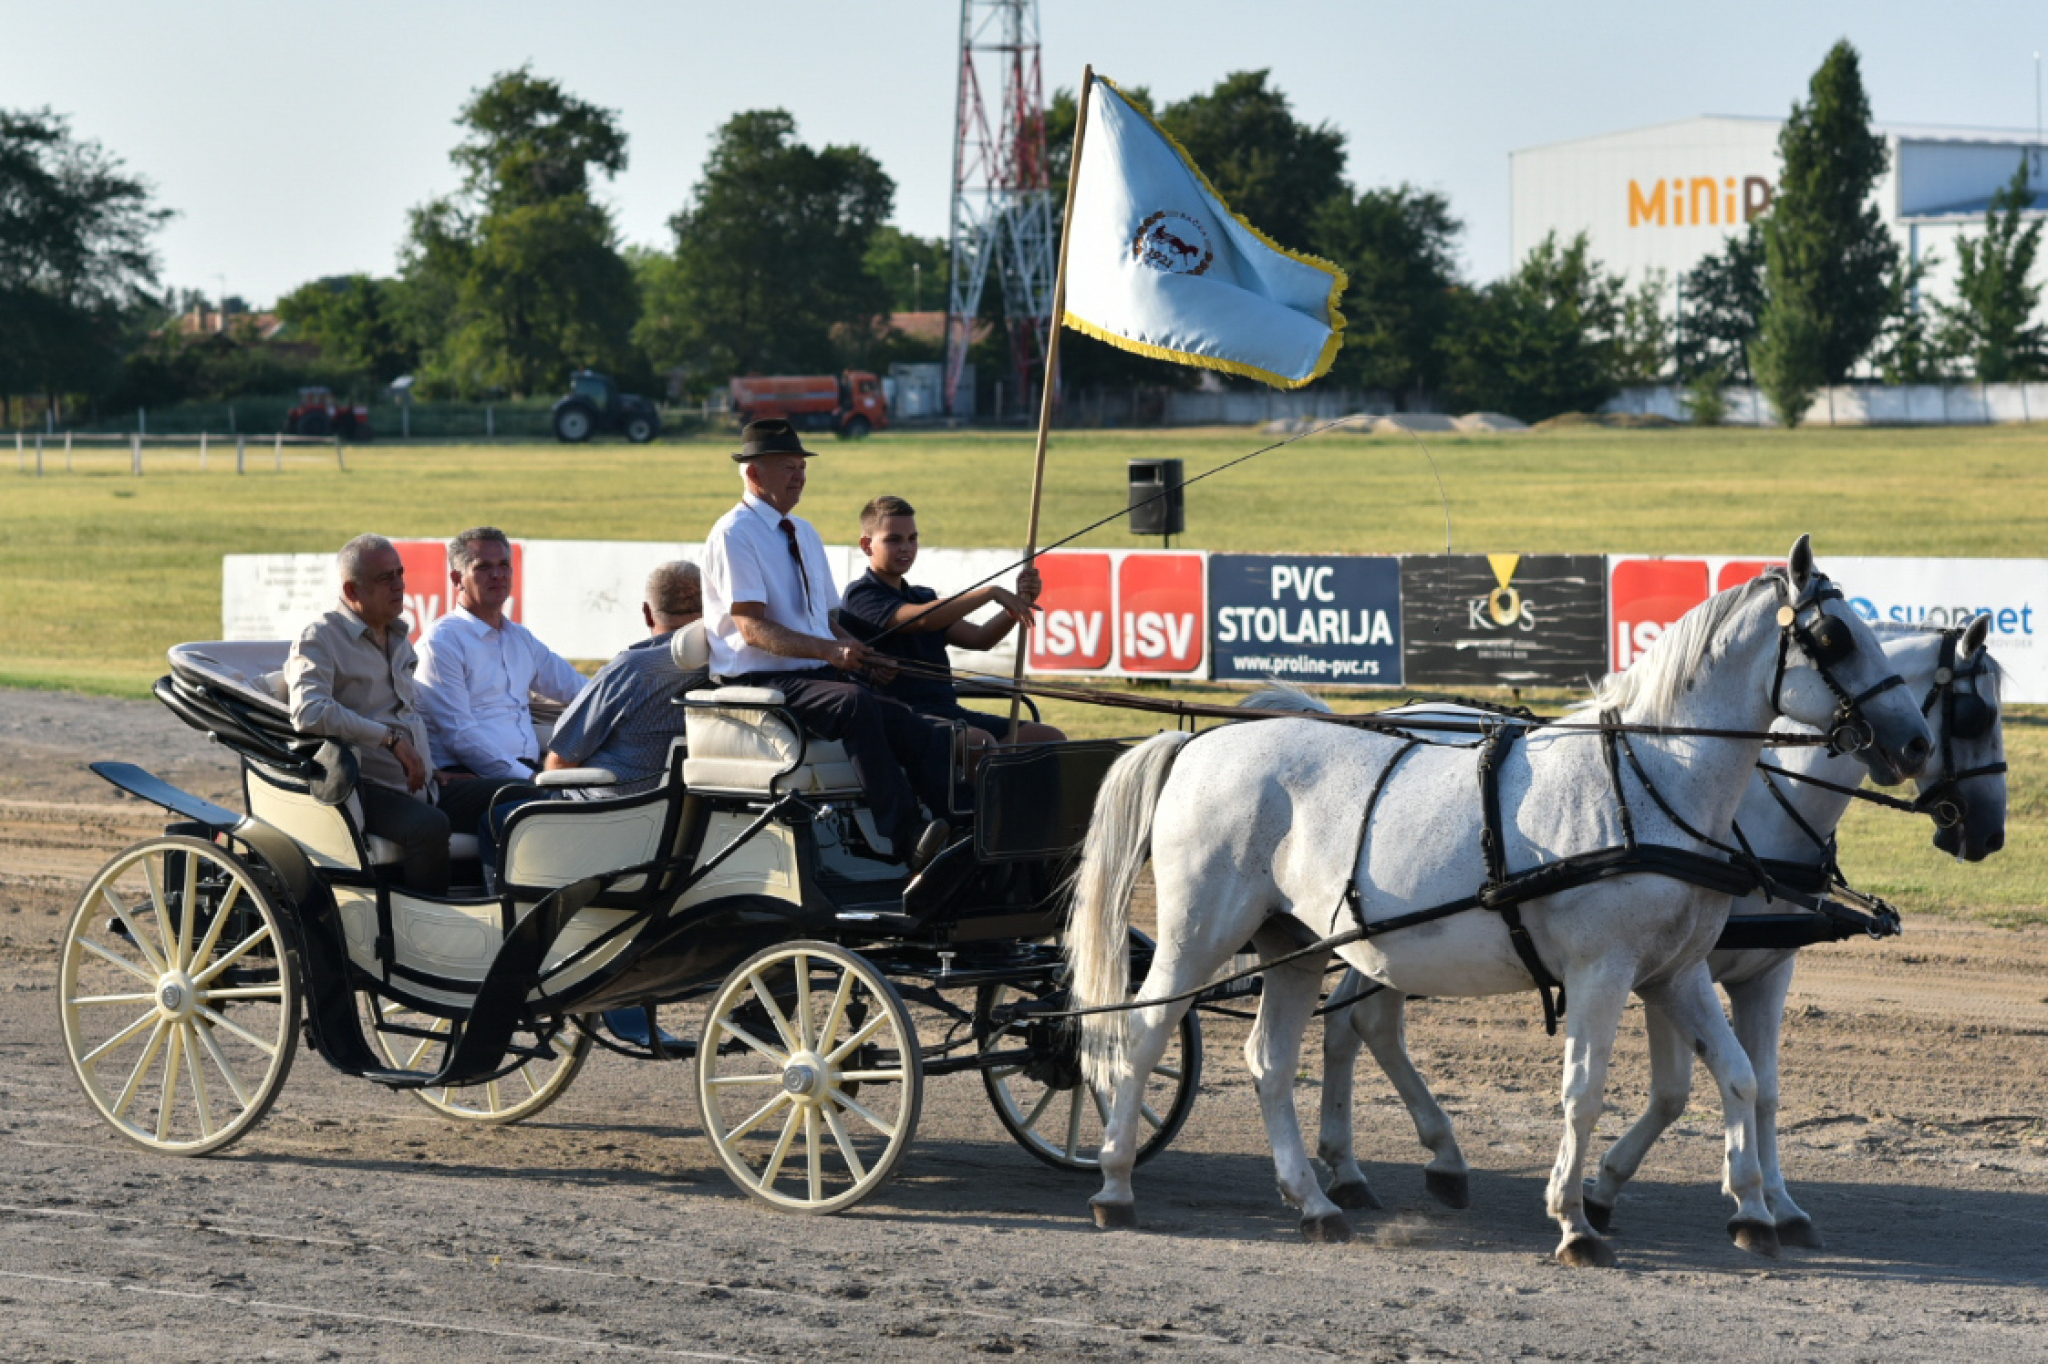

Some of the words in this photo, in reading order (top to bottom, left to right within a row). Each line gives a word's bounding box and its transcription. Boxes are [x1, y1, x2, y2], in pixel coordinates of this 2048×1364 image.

[1271, 565, 1336, 602] PVC
[1218, 606, 1394, 645] STOLARIJA
[1467, 587, 1535, 631] KOS
[1034, 609, 1104, 658] ISV
[1124, 611, 1195, 660] ISV
[1618, 620, 1676, 671] IS
[1233, 655, 1379, 678] www.proline-pvc.rs
